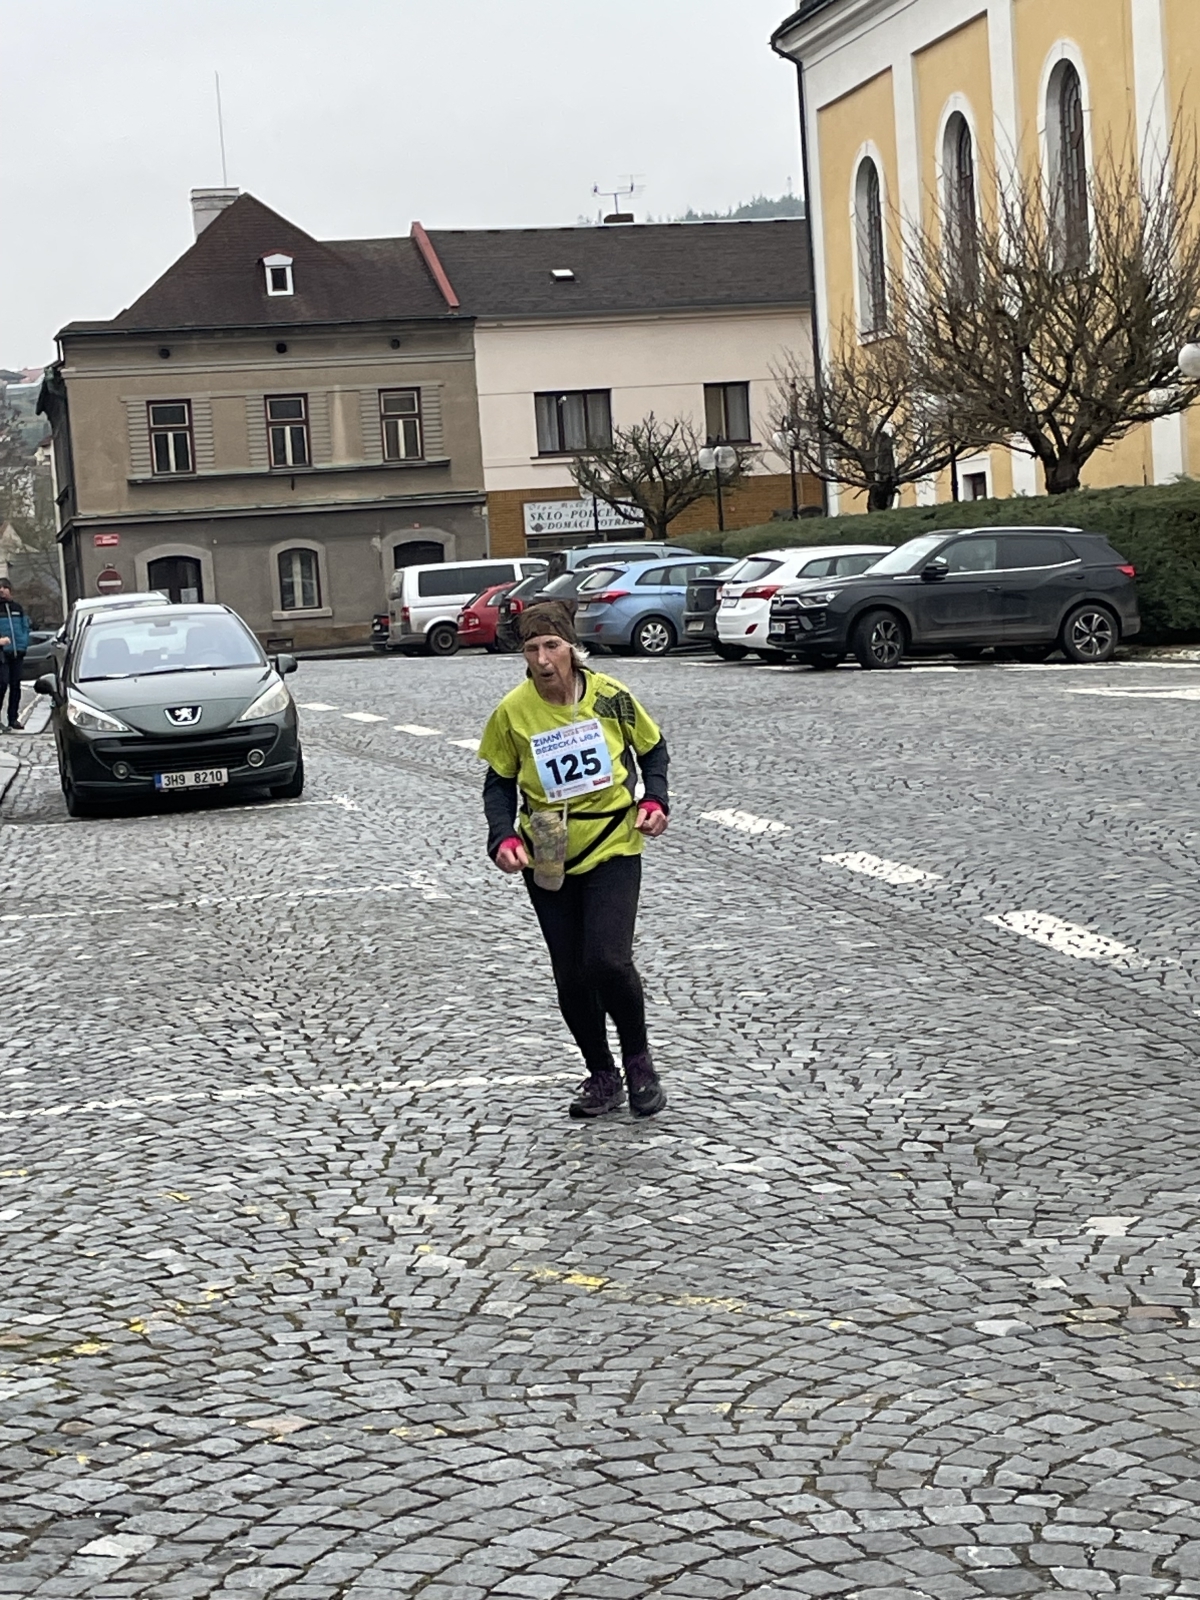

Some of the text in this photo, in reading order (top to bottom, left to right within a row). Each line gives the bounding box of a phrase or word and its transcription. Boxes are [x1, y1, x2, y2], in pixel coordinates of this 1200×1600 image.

[579, 732, 601, 743] LIGA
[545, 747, 602, 785] 125
[164, 770, 223, 787] 3H9 8210
